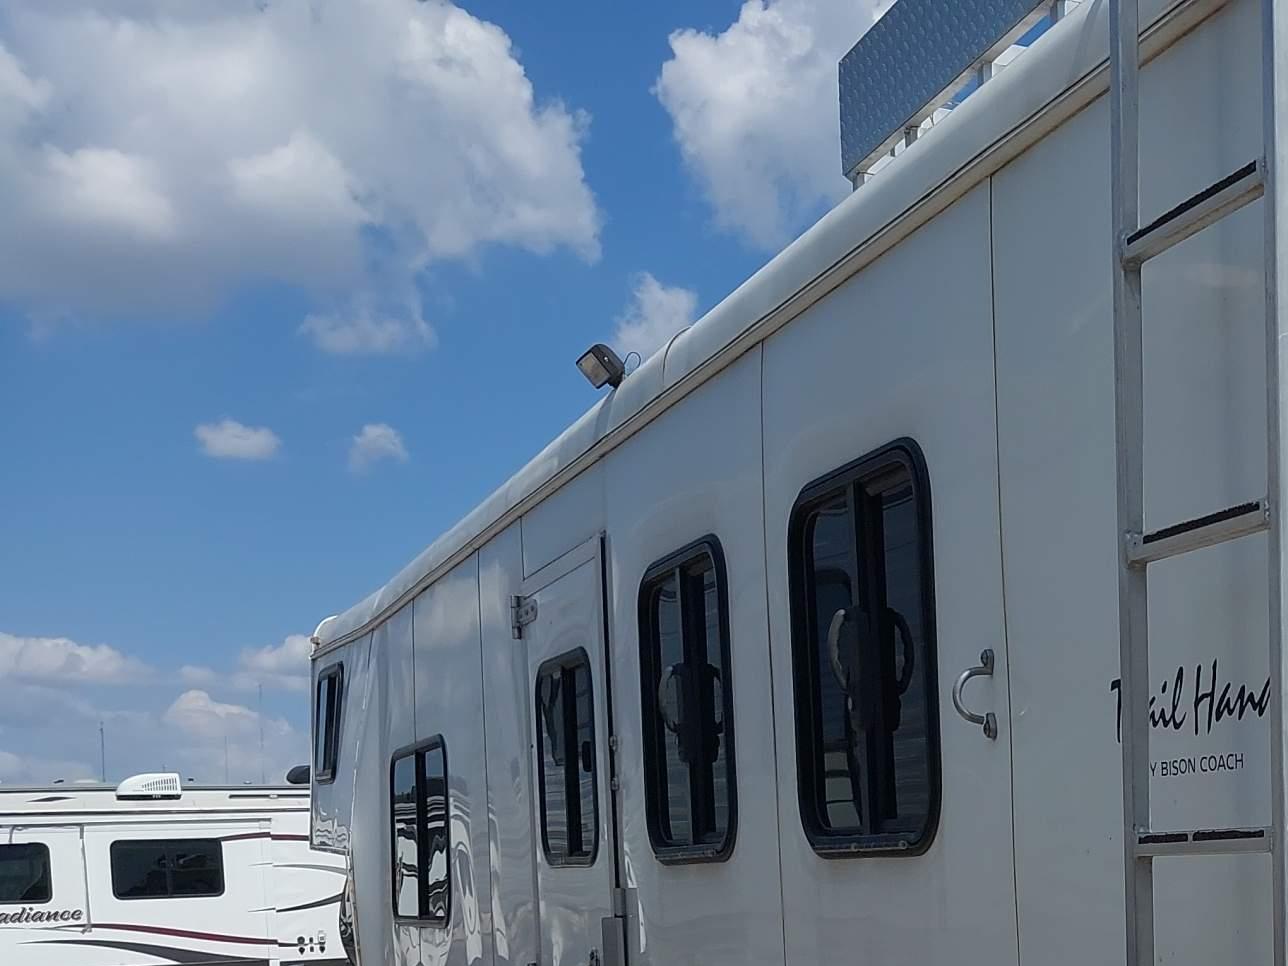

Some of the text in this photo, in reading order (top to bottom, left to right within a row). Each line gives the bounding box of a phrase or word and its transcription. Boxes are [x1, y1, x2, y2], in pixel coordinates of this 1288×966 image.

[1161, 757, 1196, 777] BISON
[1200, 753, 1244, 772] COACH
[0, 907, 82, 924] adiance
